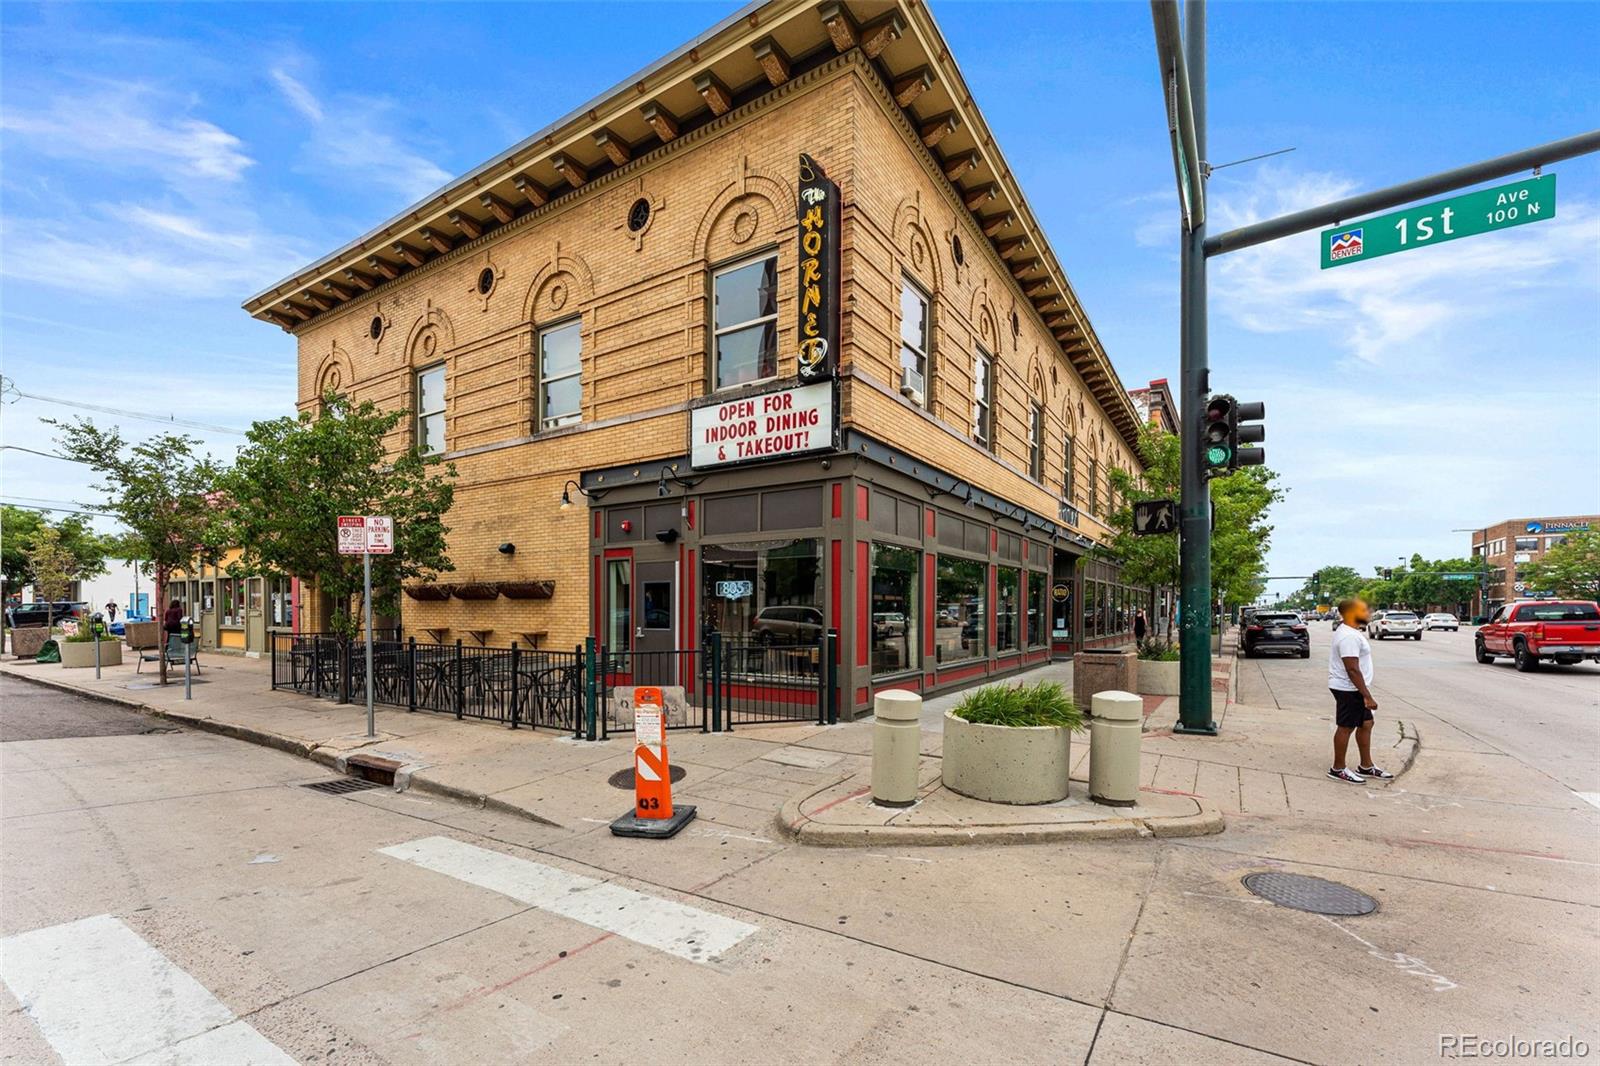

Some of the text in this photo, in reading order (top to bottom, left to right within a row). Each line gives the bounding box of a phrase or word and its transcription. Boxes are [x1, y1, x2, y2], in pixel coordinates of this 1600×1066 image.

[1496, 189, 1529, 206] Ave
[1486, 202, 1540, 224] 100 N
[1394, 206, 1455, 245] 1st
[1331, 245, 1362, 260] DENVER
[719, 393, 793, 422] OPEN FOR
[705, 408, 819, 443] INDOOR DINING
[718, 431, 809, 461] & TAKEOUT!
[723, 582, 744, 594] 805
[639, 797, 659, 810] Q3
